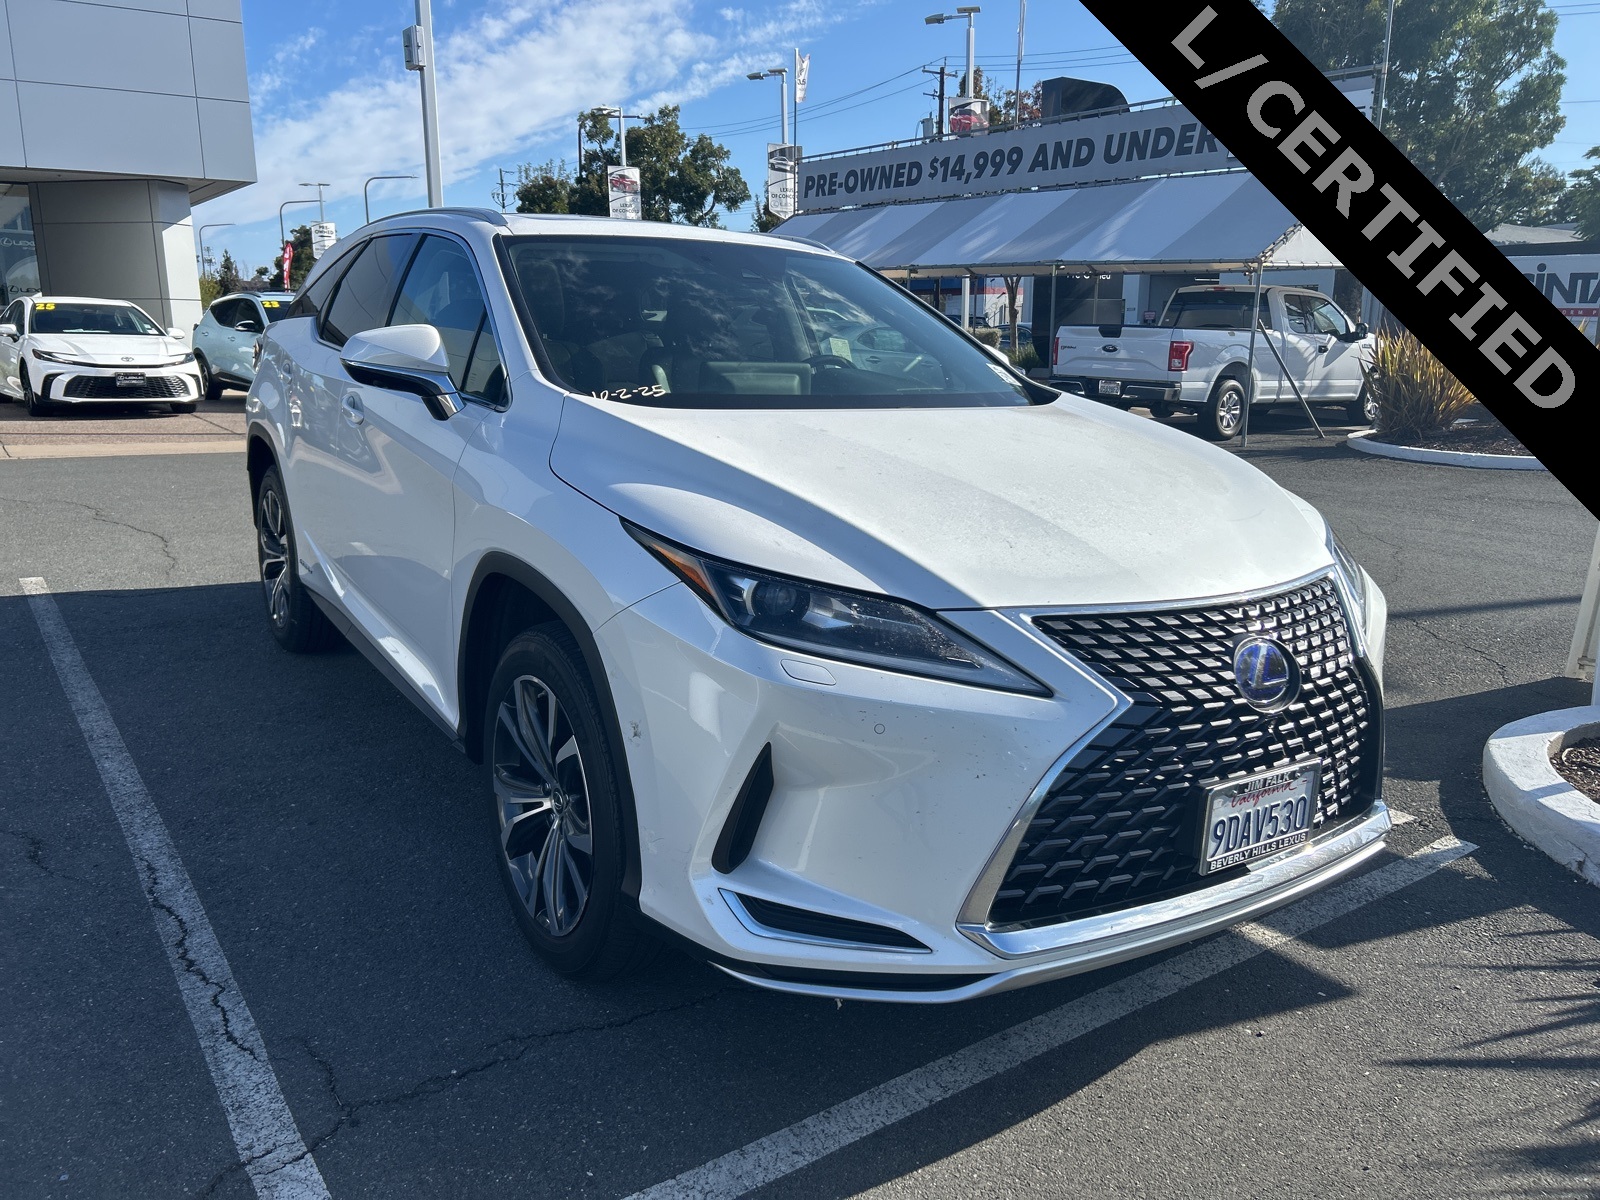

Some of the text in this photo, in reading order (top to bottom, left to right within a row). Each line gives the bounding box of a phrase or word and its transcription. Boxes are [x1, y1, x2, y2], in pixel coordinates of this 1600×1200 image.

[803, 122, 1218, 198] PRE-OWNED $14,999 AND UNDER
[1231, 782, 1297, 808] California
[1244, 771, 1291, 793] JIM FALK
[1210, 794, 1308, 860] 9DAV530
[1210, 832, 1307, 871] BEVERLY HILLS LEXUS
